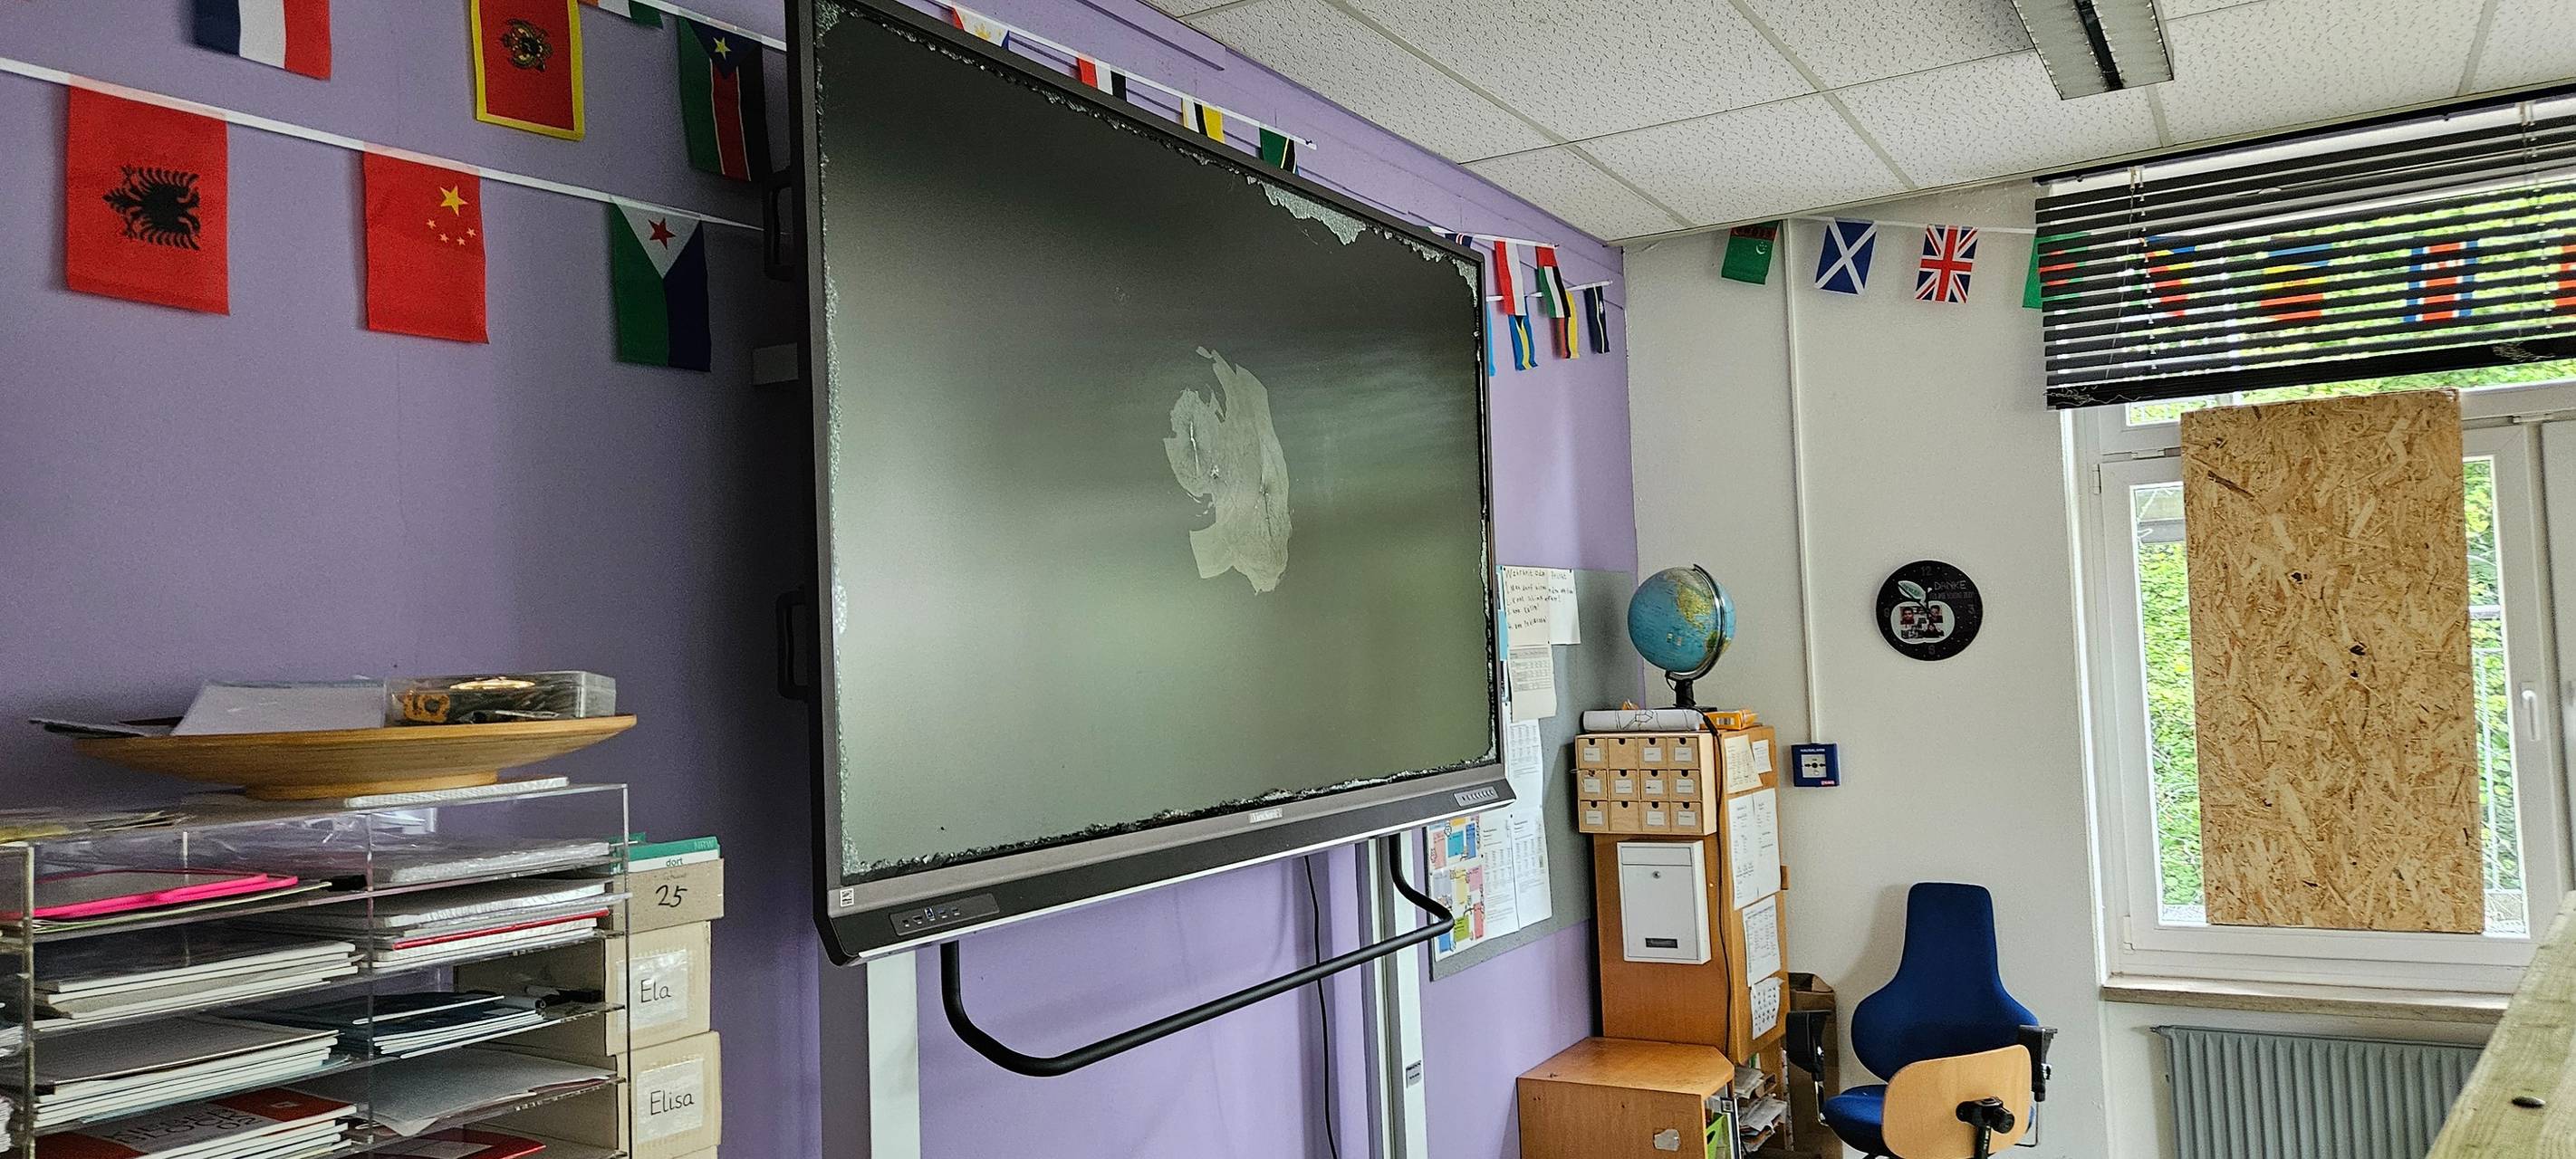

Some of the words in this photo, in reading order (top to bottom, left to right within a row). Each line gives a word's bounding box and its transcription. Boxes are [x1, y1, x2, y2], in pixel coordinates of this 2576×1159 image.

[1934, 580, 1966, 590] DANKE
[693, 839, 715, 850] NRW
[666, 857, 683, 867] dort
[655, 884, 688, 908] 25
[640, 977, 672, 1003] Ela
[650, 1089, 695, 1116] Elisa
